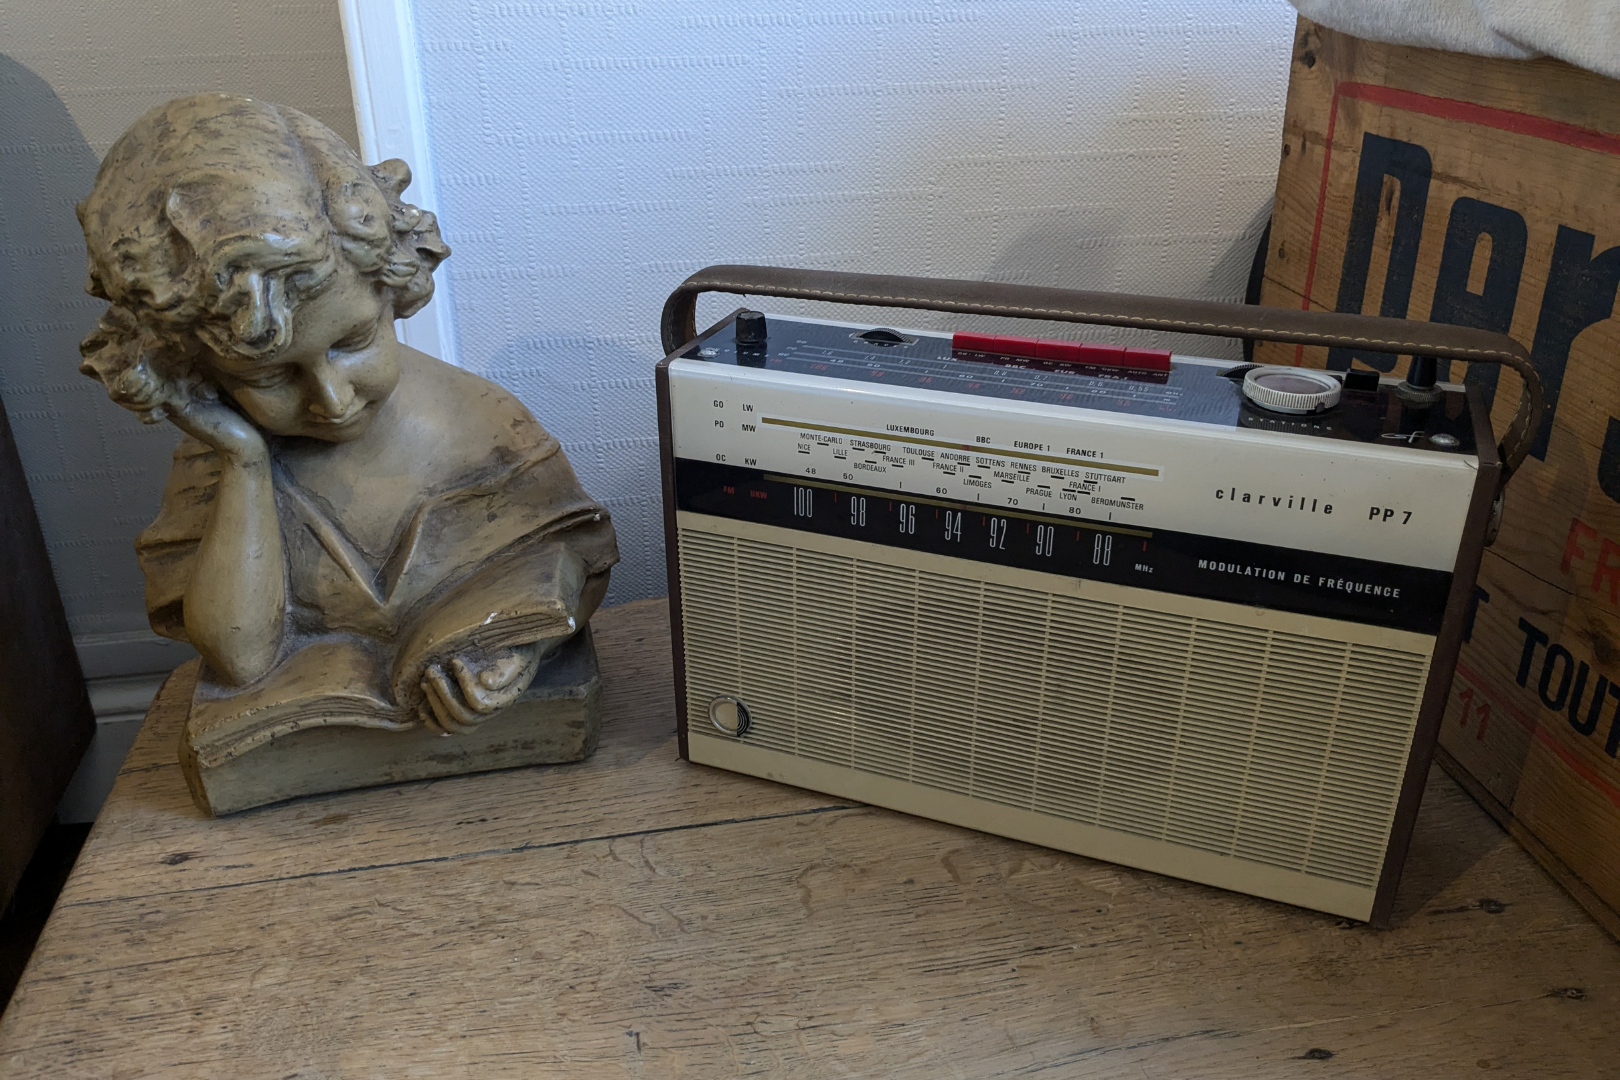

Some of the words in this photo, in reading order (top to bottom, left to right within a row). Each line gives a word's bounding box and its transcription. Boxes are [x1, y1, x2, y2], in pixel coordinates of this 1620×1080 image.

[713, 400, 724, 409] GO
[742, 404, 754, 413] LW
[714, 420, 725, 428] PO
[741, 424, 757, 433] MW
[1248, 416, 1332, 431] STATIONS
[797, 442, 812, 451] NICE
[886, 424, 935, 437] LUXEMBOURG
[975, 436, 991, 444] BBC
[1013, 441, 1044, 452] EUROPE
[1066, 447, 1097, 458] FRANCE
[799, 432, 843, 445] MONTE-CARLO
[849, 439, 892, 452] STRASBOURG
[902, 446, 936, 458] TOULOUSE
[939, 452, 971, 463] ANDORRE
[975, 456, 1006, 468] SOTTENS
[1010, 461, 1037, 472] RENNES
[1041, 465, 1080, 478] BRUXELLES
[1084, 471, 1127, 484] STUTTGART
[832, 448, 849, 457] LILLE
[715, 453, 727, 462] OC
[744, 458, 757, 467] KW
[882, 454, 907, 465] FRANCE
[853, 462, 887, 473] BORDEAUX
[932, 461, 958, 473] FRANCE
[993, 470, 1031, 483] MARSEILLE
[963, 478, 993, 489] LIMOGES
[1068, 481, 1096, 492] FRANCE
[723, 485, 735, 495] FM
[749, 490, 768, 499] UKW
[805, 467, 817, 475] 48
[842, 472, 854, 481] 50
[935, 487, 948, 495] 60
[1007, 497, 1019, 506] 70
[1068, 506, 1082, 515] 80
[1025, 487, 1053, 498] PRAGUE
[1059, 492, 1078, 502] LYON
[1090, 496, 1145, 511] BEROMUNSTER
[1215, 487, 1334, 515] clarville
[793, 486, 813, 518] 100
[850, 495, 866, 527] 98
[899, 503, 916, 535] 96
[944, 510, 962, 543] 94
[989, 517, 1007, 550] 92
[1035, 524, 1055, 557] 90
[1092, 533, 1113, 566] 88
[1134, 563, 1154, 574] MHz
[1198, 559, 1286, 581] MODULATION
[1293, 573, 1311, 585] DE
[1318, 576, 1401, 599] FRÉQUENCE
